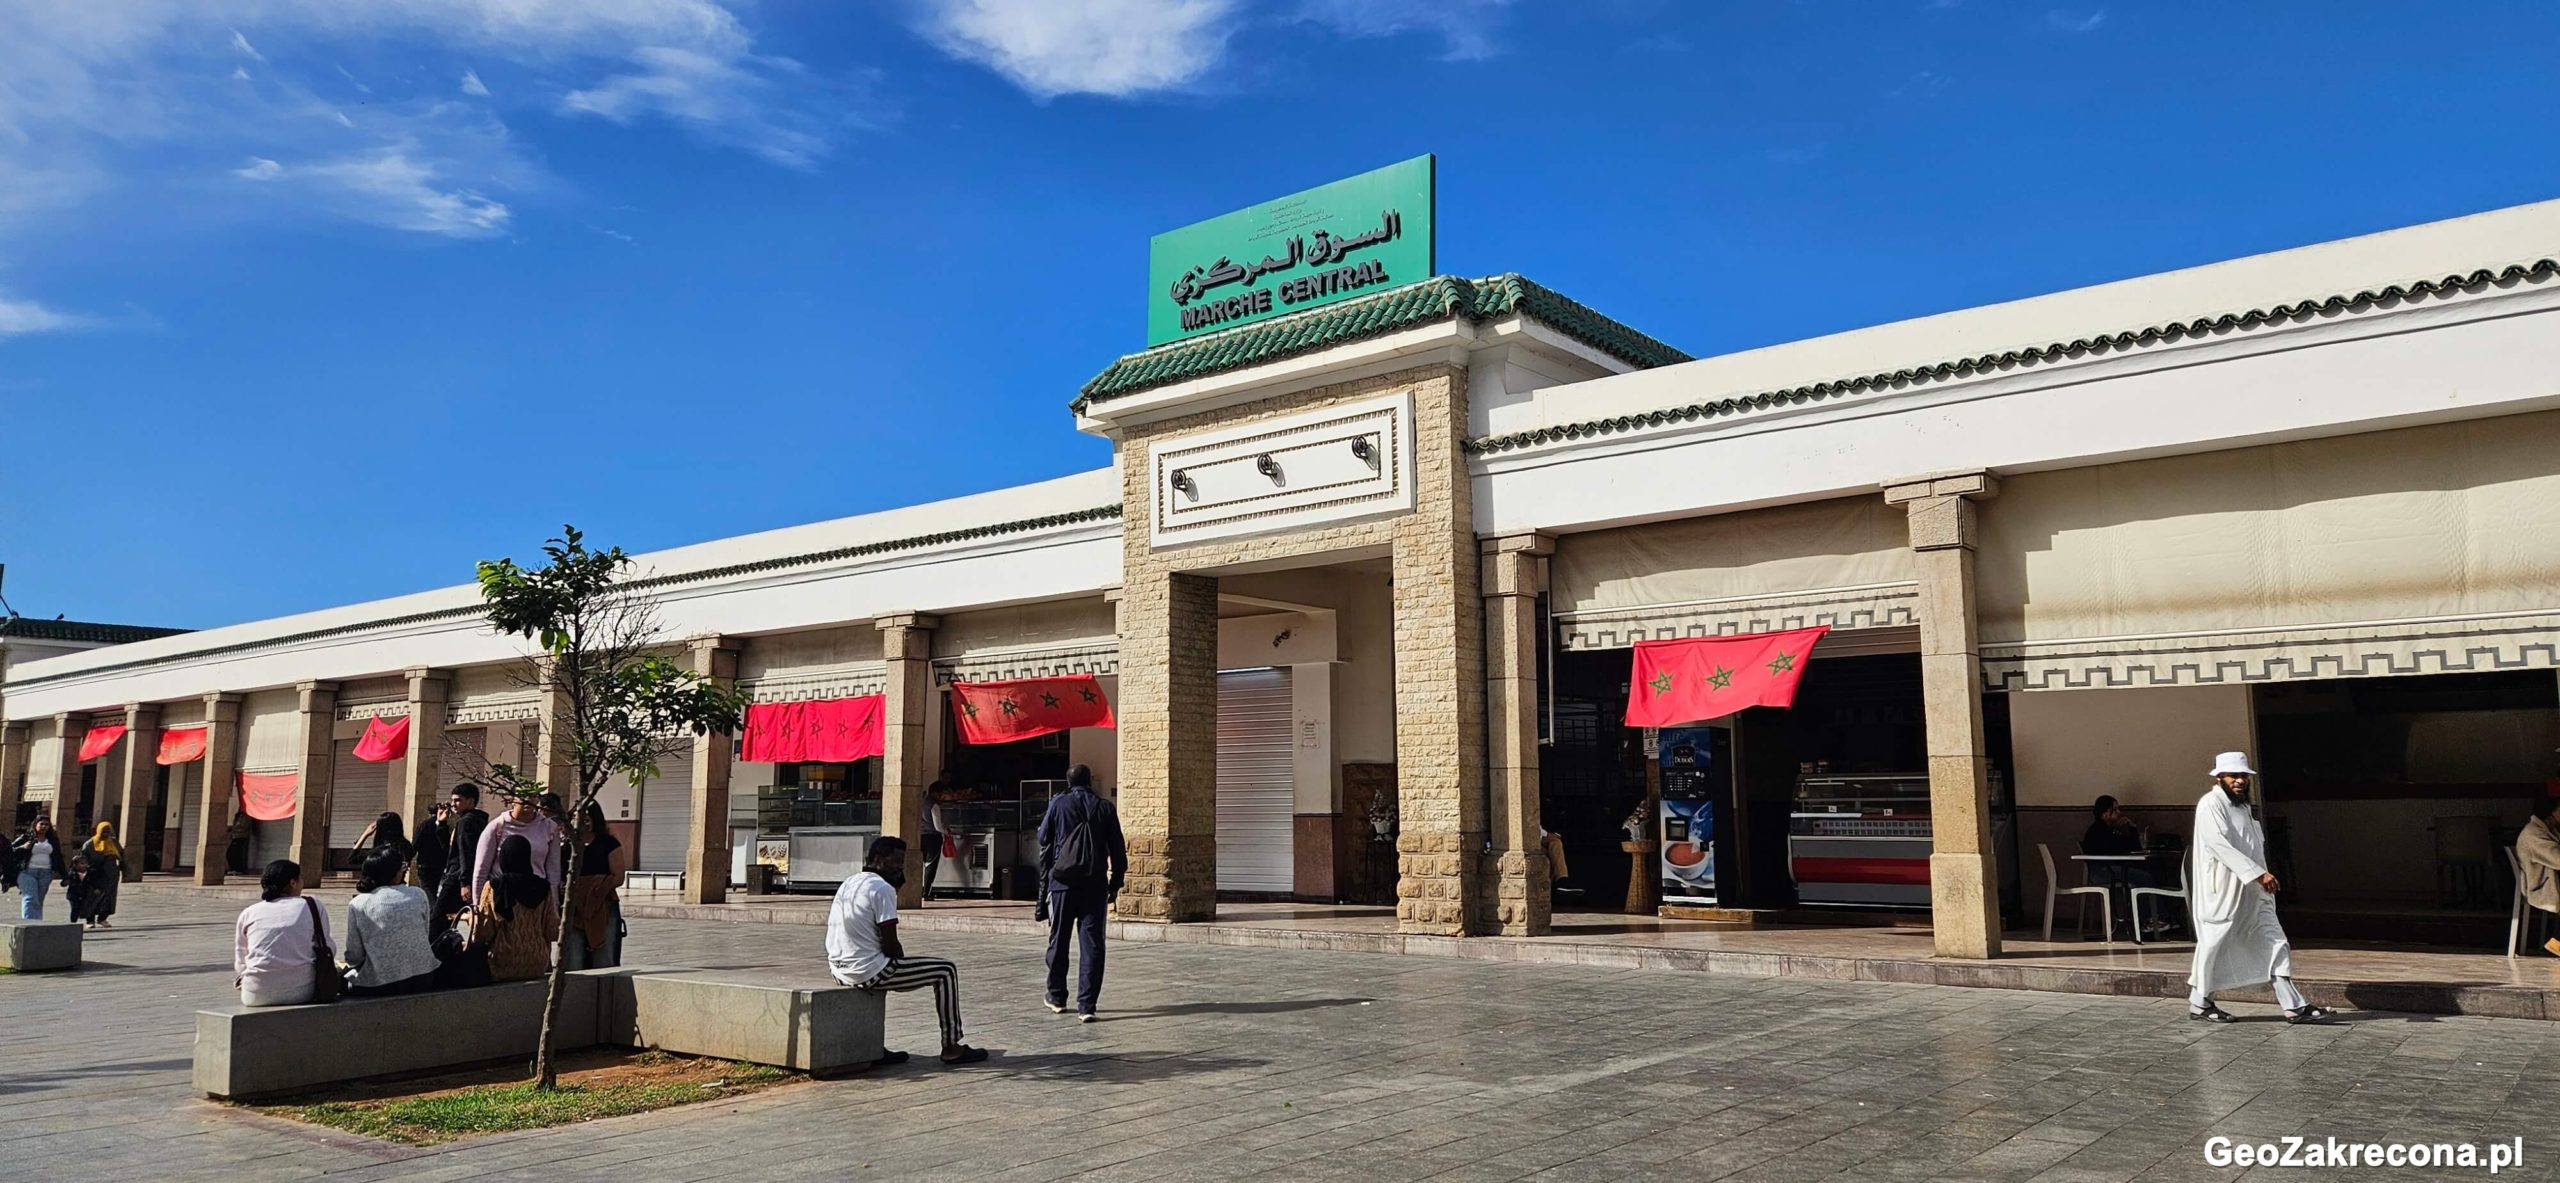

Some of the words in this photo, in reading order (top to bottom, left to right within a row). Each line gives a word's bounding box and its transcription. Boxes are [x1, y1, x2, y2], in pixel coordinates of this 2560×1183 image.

[1171, 233, 1304, 306] المركزي
[1305, 208, 1401, 266] السوق
[1180, 288, 1271, 331] MARCHE
[1278, 258, 1389, 302] CENTRAL
